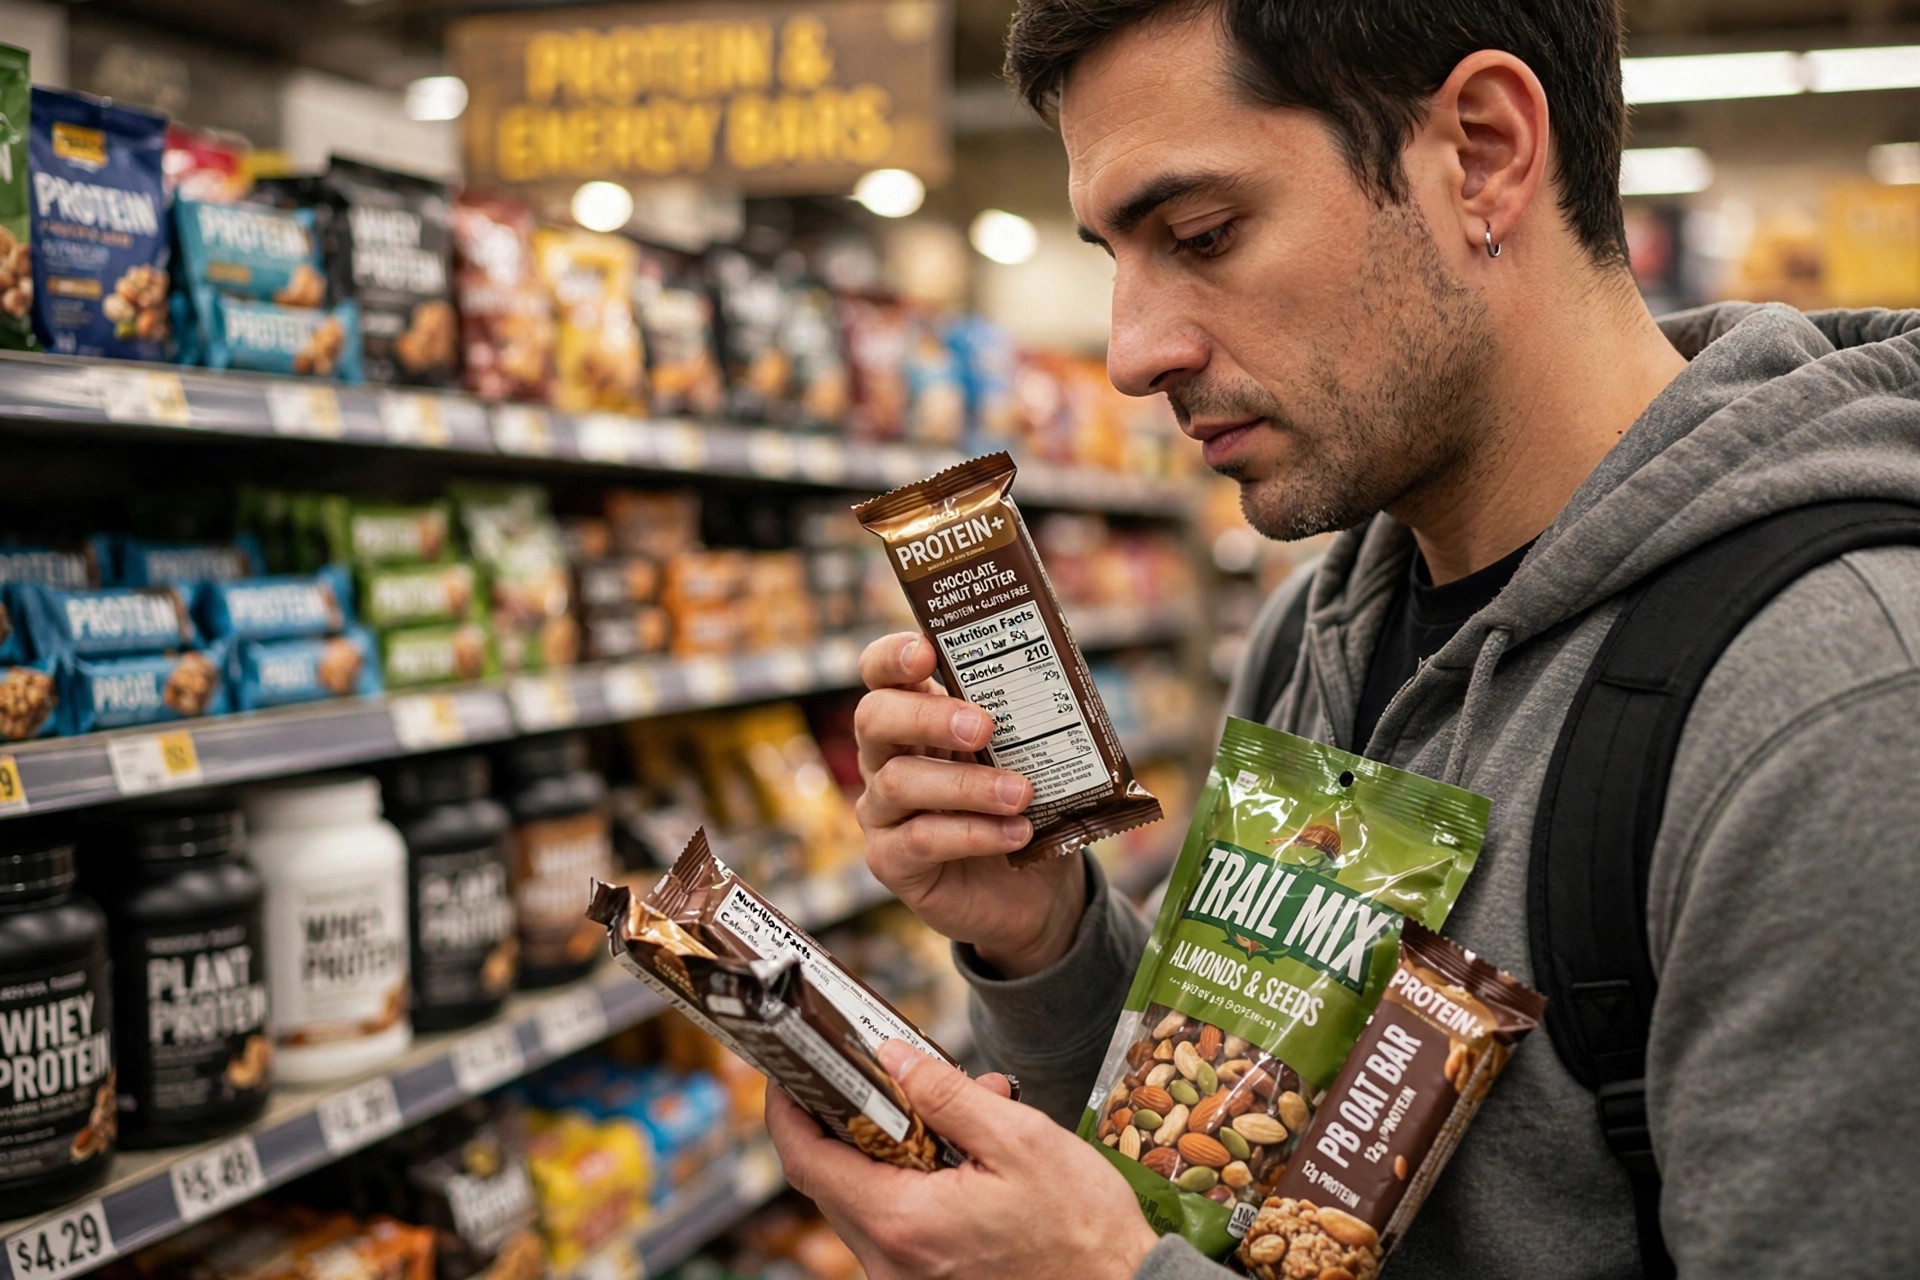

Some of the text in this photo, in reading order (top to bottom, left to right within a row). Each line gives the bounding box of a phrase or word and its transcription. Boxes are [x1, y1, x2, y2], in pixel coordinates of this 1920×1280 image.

[523, 24, 774, 97] PROTEIN
[500, 86, 892, 181] ENERGY BARS
[33, 171, 158, 238] PROTEIN
[896, 514, 1005, 571] PROTEIN+
[927, 569, 1017, 612] PEANUT BUTTER
[932, 561, 998, 594] CHOCOLATE
[943, 604, 975, 624] PROTEIN
[981, 591, 1010, 609] GLUTEN
[1010, 584, 1030, 599] FREE
[66, 594, 180, 640] PROTEIN
[943, 610, 1034, 649] Nutrition Facts
[1025, 643, 1050, 662] 210
[735, 889, 811, 960] Nutrition Facts
[1188, 848, 1391, 984] TRAIL MIX
[147, 945, 252, 999] PLANT
[1169, 940, 1248, 991] ALMONDS
[1243, 970, 1262, 998] &
[1259, 977, 1324, 1027] SEEDS
[0, 991, 95, 1057] WHEY
[1388, 968, 1484, 1039] PROTEIN+
[1317, 1024, 1422, 1169] PB OAT BAR
[1363, 1141, 1389, 1164] 12g
[1301, 1160, 1361, 1209] 12g PROTEIN
[17, 1211, 102, 1274] $4.29
